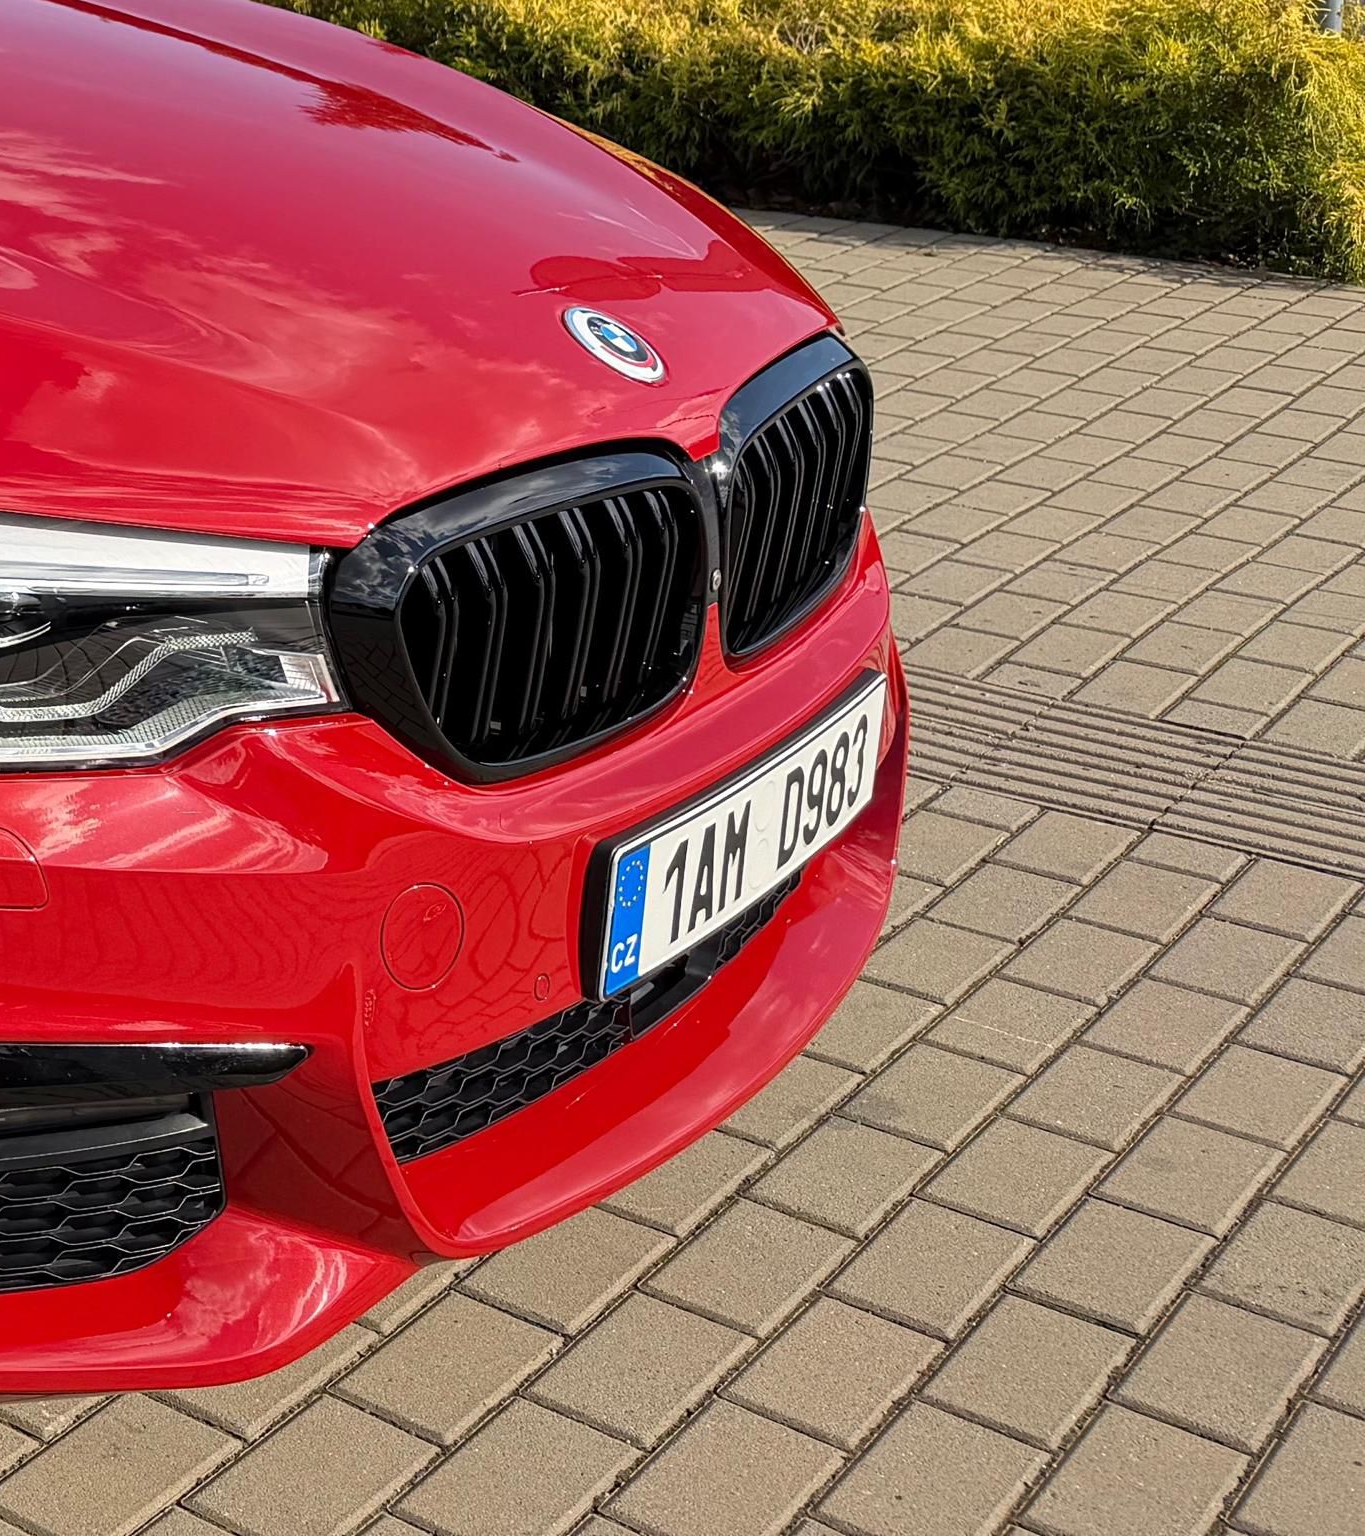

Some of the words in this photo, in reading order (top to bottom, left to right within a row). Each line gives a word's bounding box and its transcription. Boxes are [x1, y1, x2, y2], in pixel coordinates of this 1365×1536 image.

[663, 799, 752, 945] 1AM
[777, 713, 869, 870] D983
[610, 931, 638, 975] CZ
